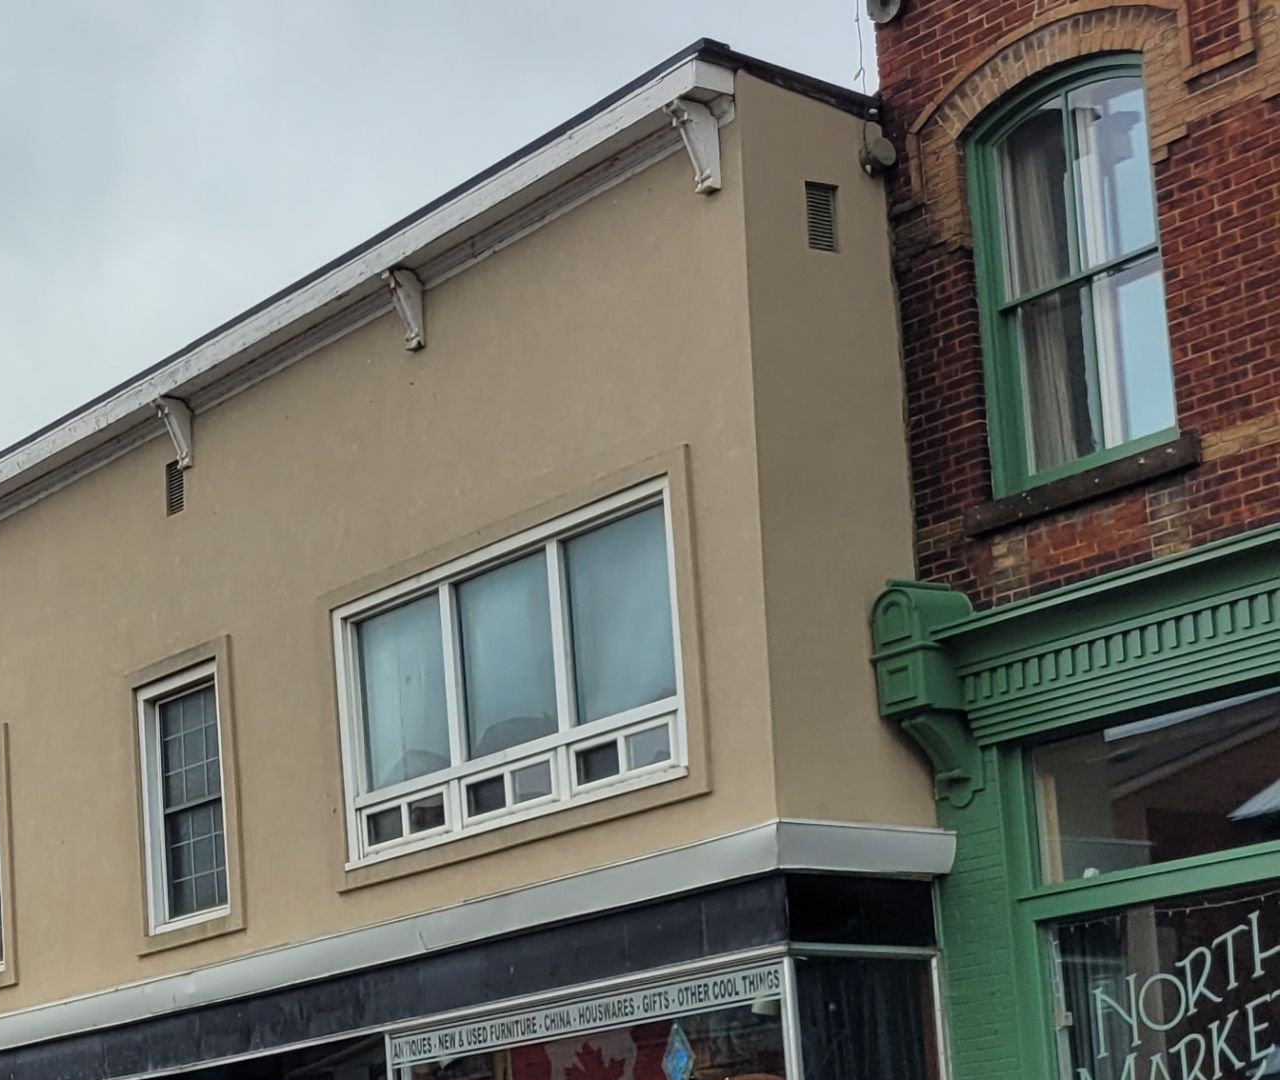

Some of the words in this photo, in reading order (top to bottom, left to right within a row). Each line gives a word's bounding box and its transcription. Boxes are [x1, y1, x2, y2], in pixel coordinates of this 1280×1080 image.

[393, 1036, 433, 1061] ANTIQUES
[439, 1032, 456, 1050] NEW
[458, 1030, 465, 1047] &
[466, 1026, 488, 1046] USED
[490, 1016, 538, 1043] FURNITURE
[544, 1009, 572, 1033] CHINA
[578, 997, 636, 1027] HOUSWARES
[642, 991, 670, 1013] GIFTS
[677, 983, 710, 1007] OTHER
[712, 976, 740, 999] COOL
[742, 969, 780, 995] THINGS
